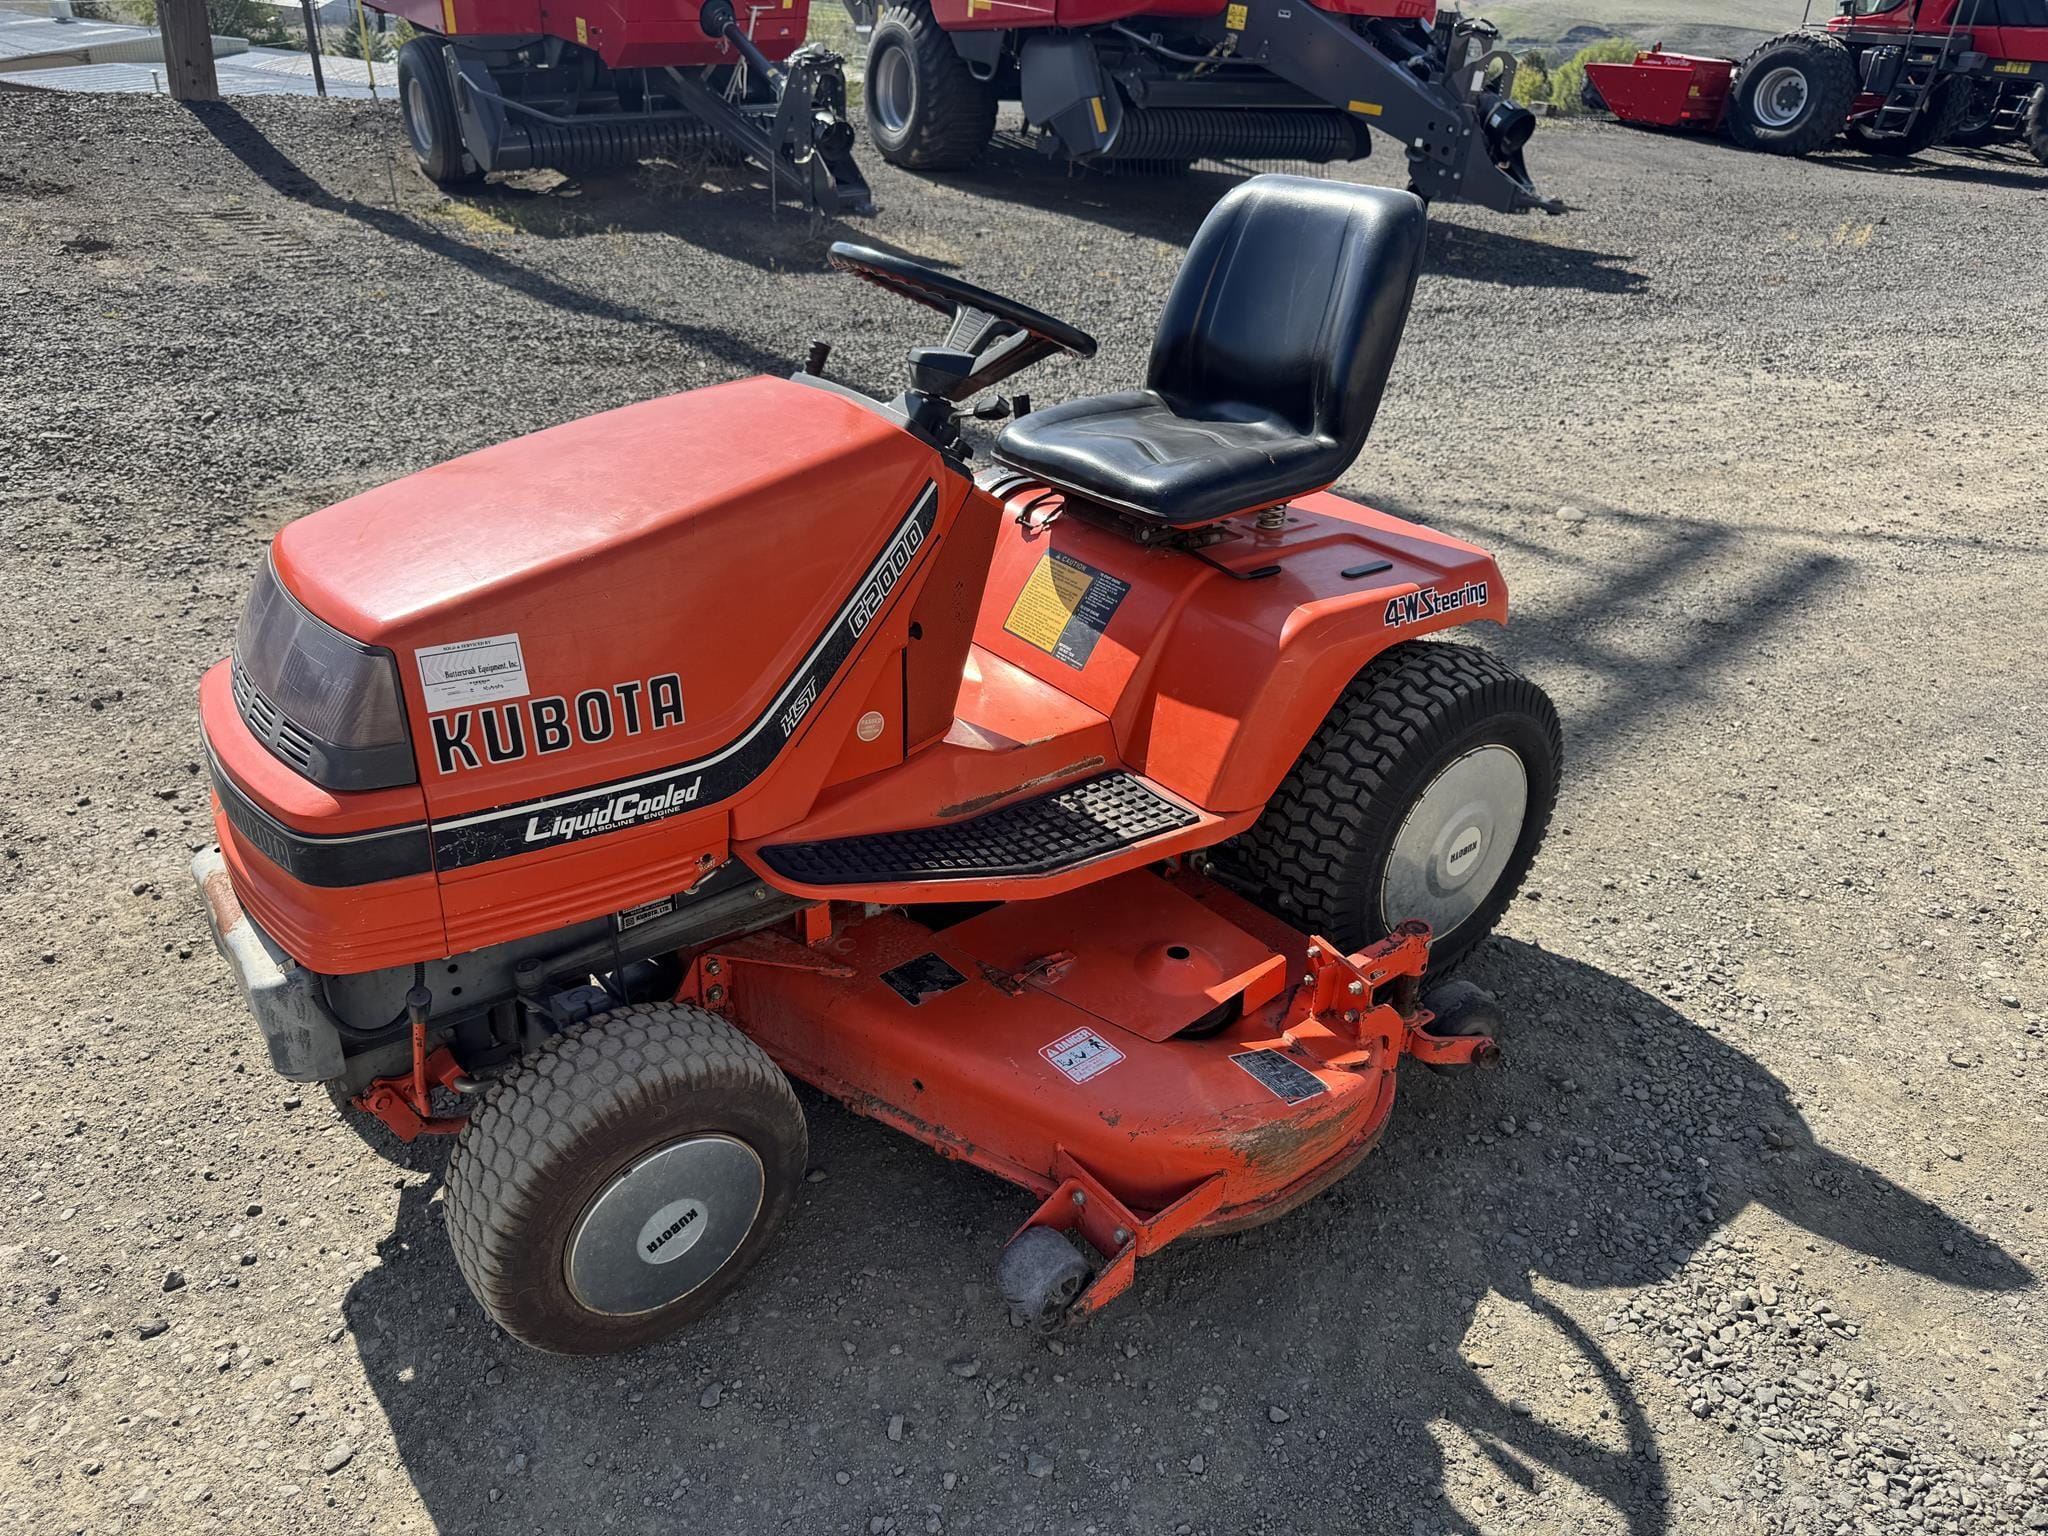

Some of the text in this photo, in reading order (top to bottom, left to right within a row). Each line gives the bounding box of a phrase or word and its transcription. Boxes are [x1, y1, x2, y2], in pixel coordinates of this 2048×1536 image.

[849, 520, 924, 638] G2000
[1062, 556, 1087, 572] CAUTION
[429, 673, 686, 775] KUBOTA
[780, 676, 817, 737] HST
[582, 806, 681, 836] GASOLINE ENGINE
[1054, 1029, 1093, 1052] DANGER
[646, 1208, 698, 1253] KUBOTA
